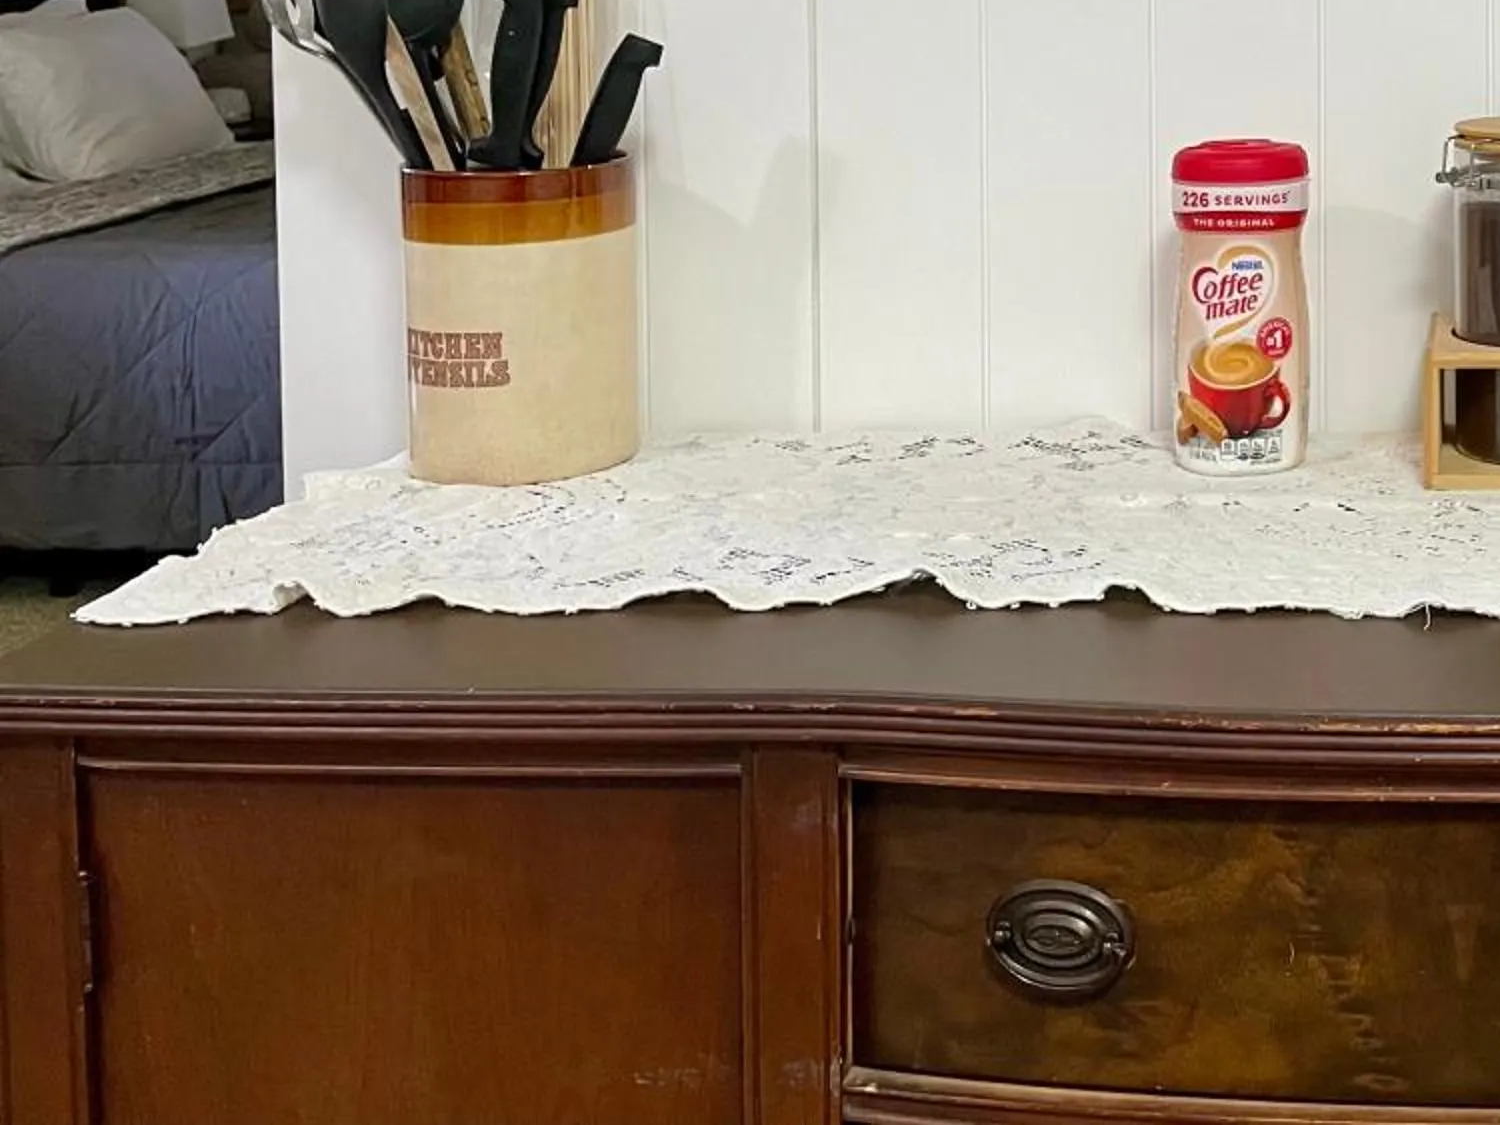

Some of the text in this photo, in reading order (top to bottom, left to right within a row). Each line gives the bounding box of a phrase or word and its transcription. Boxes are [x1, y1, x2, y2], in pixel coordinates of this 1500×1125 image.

[1183, 191, 1209, 207] 226
[1193, 218, 1275, 227] THE ORIGINAL
[1192, 266, 1263, 304] Coffee
[1206, 294, 1258, 321] mate
[408, 357, 511, 388] TENSILS
